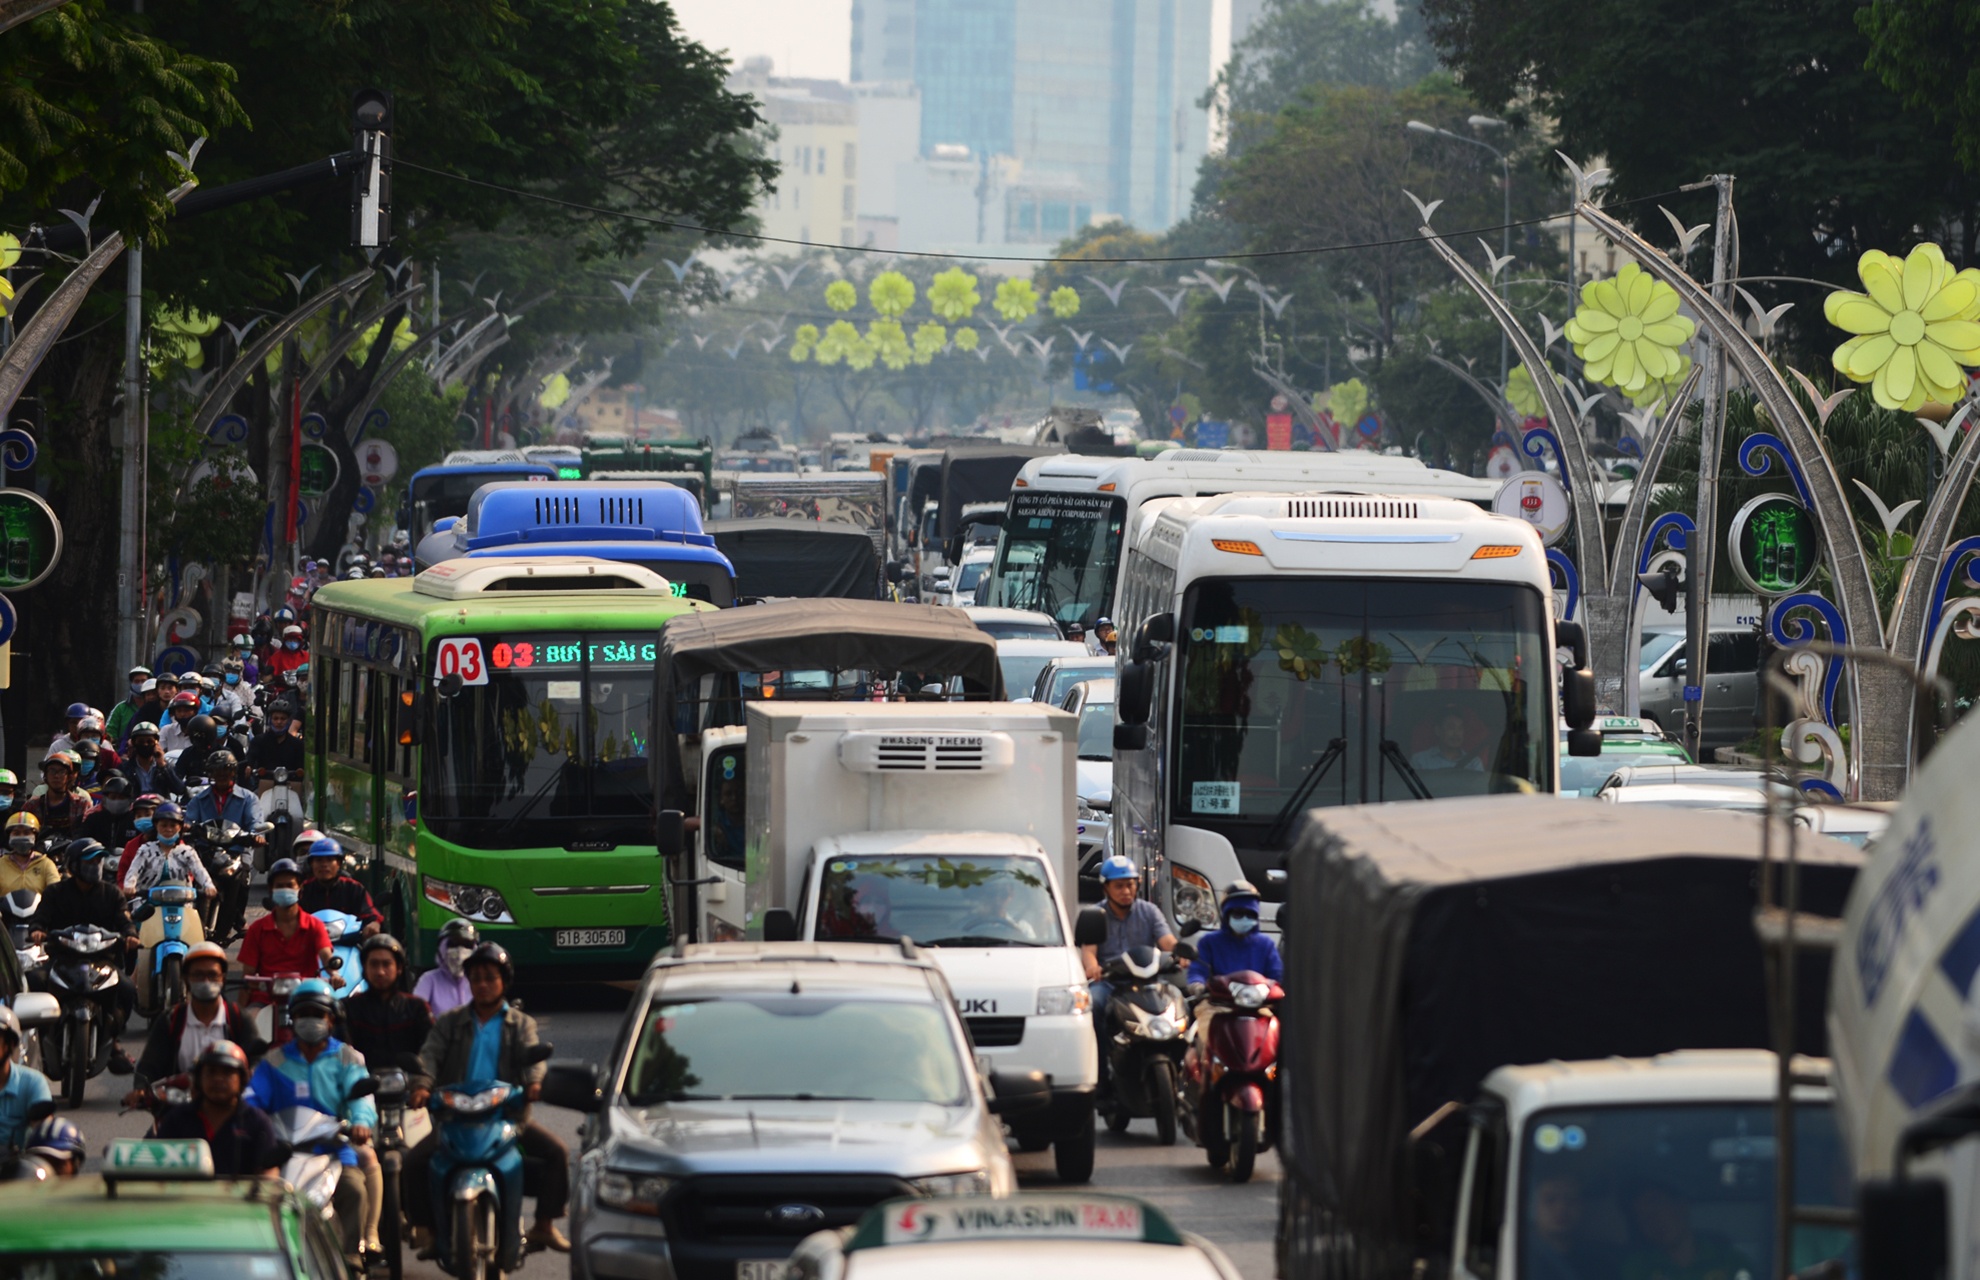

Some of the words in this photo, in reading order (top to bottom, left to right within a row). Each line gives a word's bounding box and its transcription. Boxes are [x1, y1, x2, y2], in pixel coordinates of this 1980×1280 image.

[1062, 510, 1102, 519] CORPORATION
[440, 642, 480, 681] 03
[938, 737, 983, 745] THERMO
[954, 1205, 1077, 1230] VINASUN
[1082, 1203, 1138, 1230] TAXI
